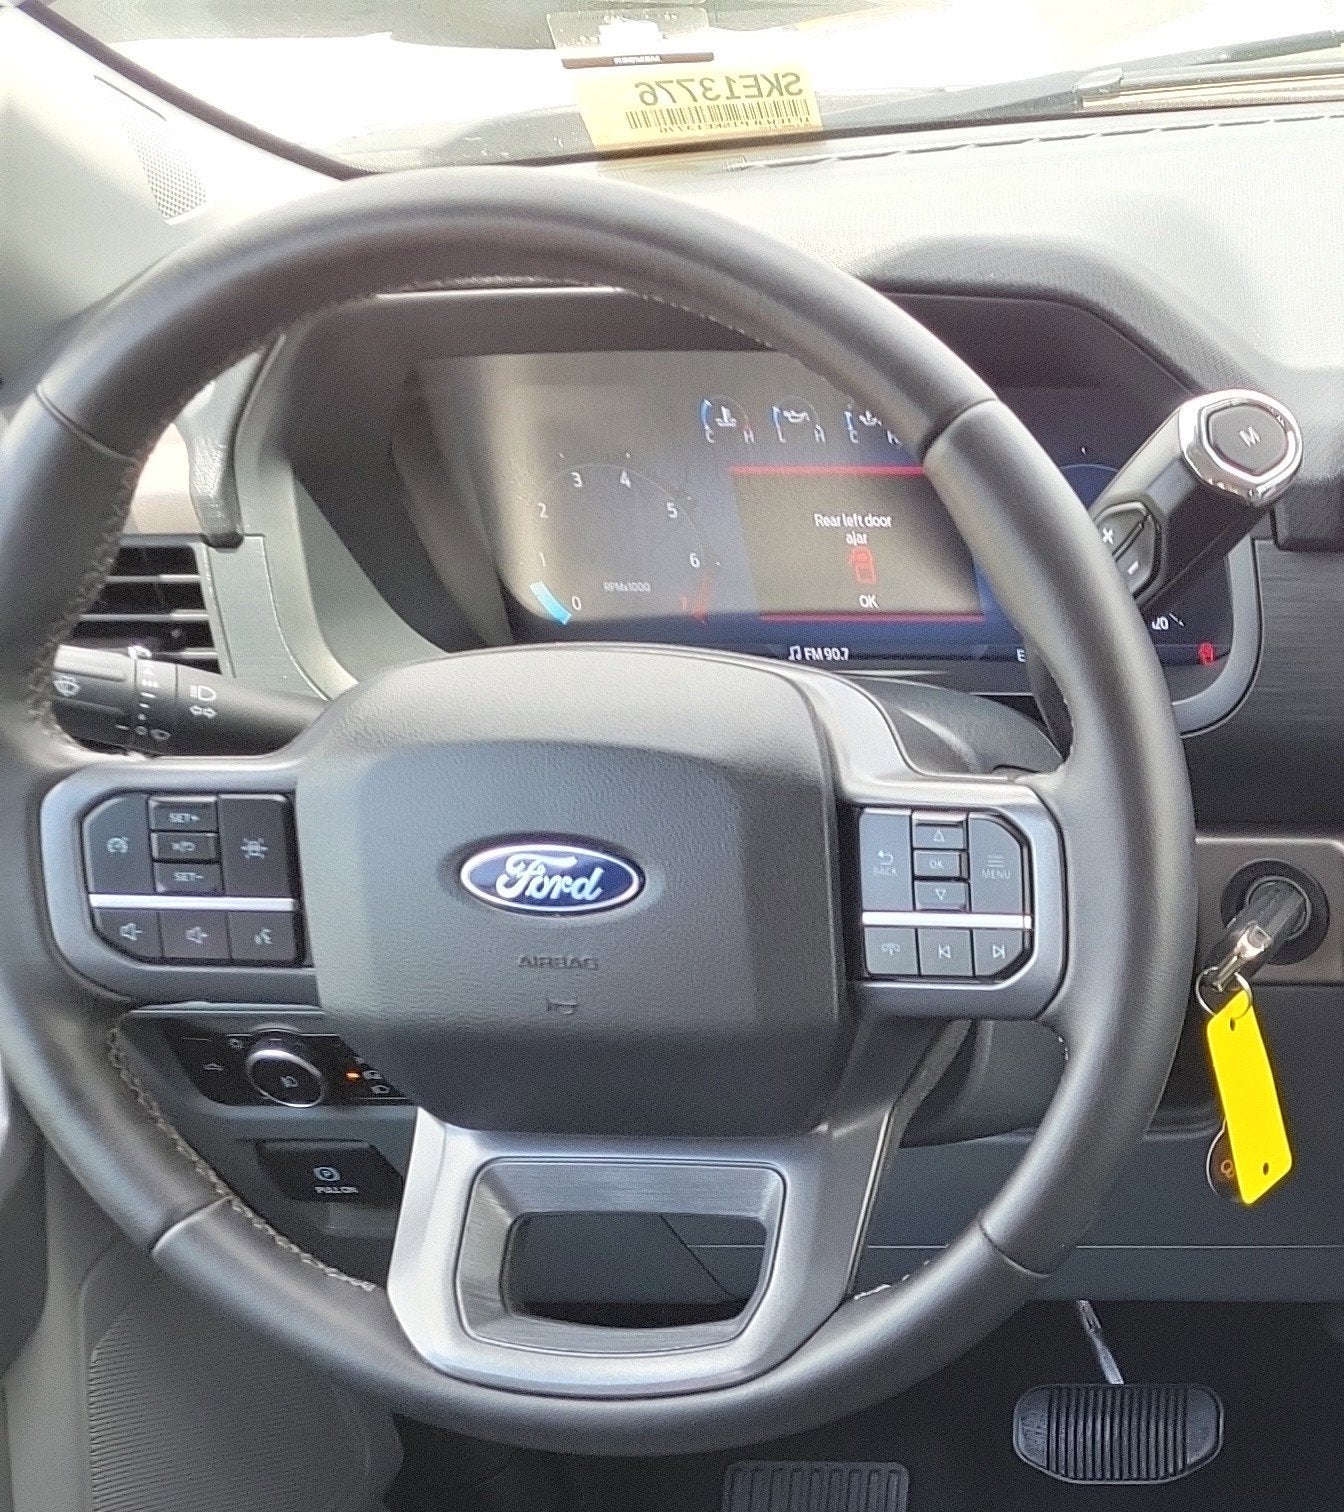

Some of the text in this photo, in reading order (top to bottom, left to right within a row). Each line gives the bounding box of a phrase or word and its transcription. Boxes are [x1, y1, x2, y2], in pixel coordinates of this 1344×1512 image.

[1239, 427, 1261, 447] M
[572, 472, 583, 488] 3
[620, 471, 631, 488] 4
[538, 503, 548, 518] 2
[667, 502, 678, 518] 5
[814, 513, 892, 528] Rear left door
[846, 531, 867, 546] ajar
[690, 553, 700, 568] 6
[571, 596, 582, 610] 0
[859, 594, 878, 609] OK
[803, 647, 849, 661] FM 90.7
[495, 851, 605, 901] Ford
[981, 869, 1011, 880] MENU
